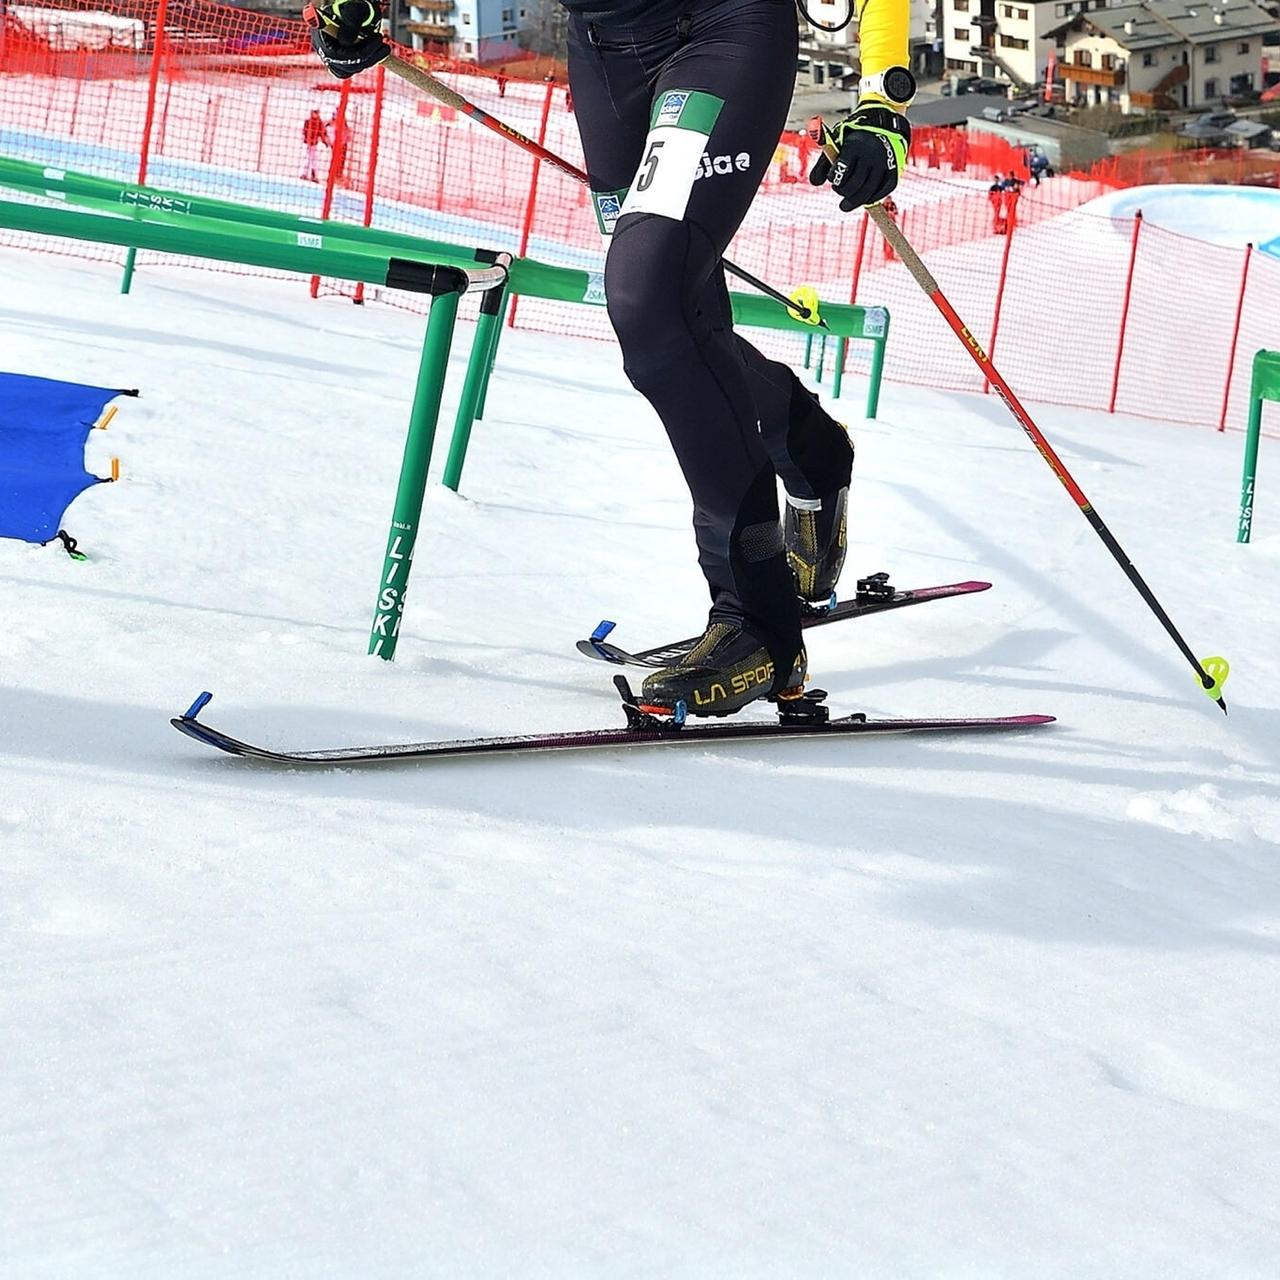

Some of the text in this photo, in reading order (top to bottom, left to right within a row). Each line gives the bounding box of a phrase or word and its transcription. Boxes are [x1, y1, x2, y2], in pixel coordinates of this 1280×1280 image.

[636, 141, 665, 192] 5
[373, 535, 404, 656] LISKI
[693, 683, 728, 706] LA
